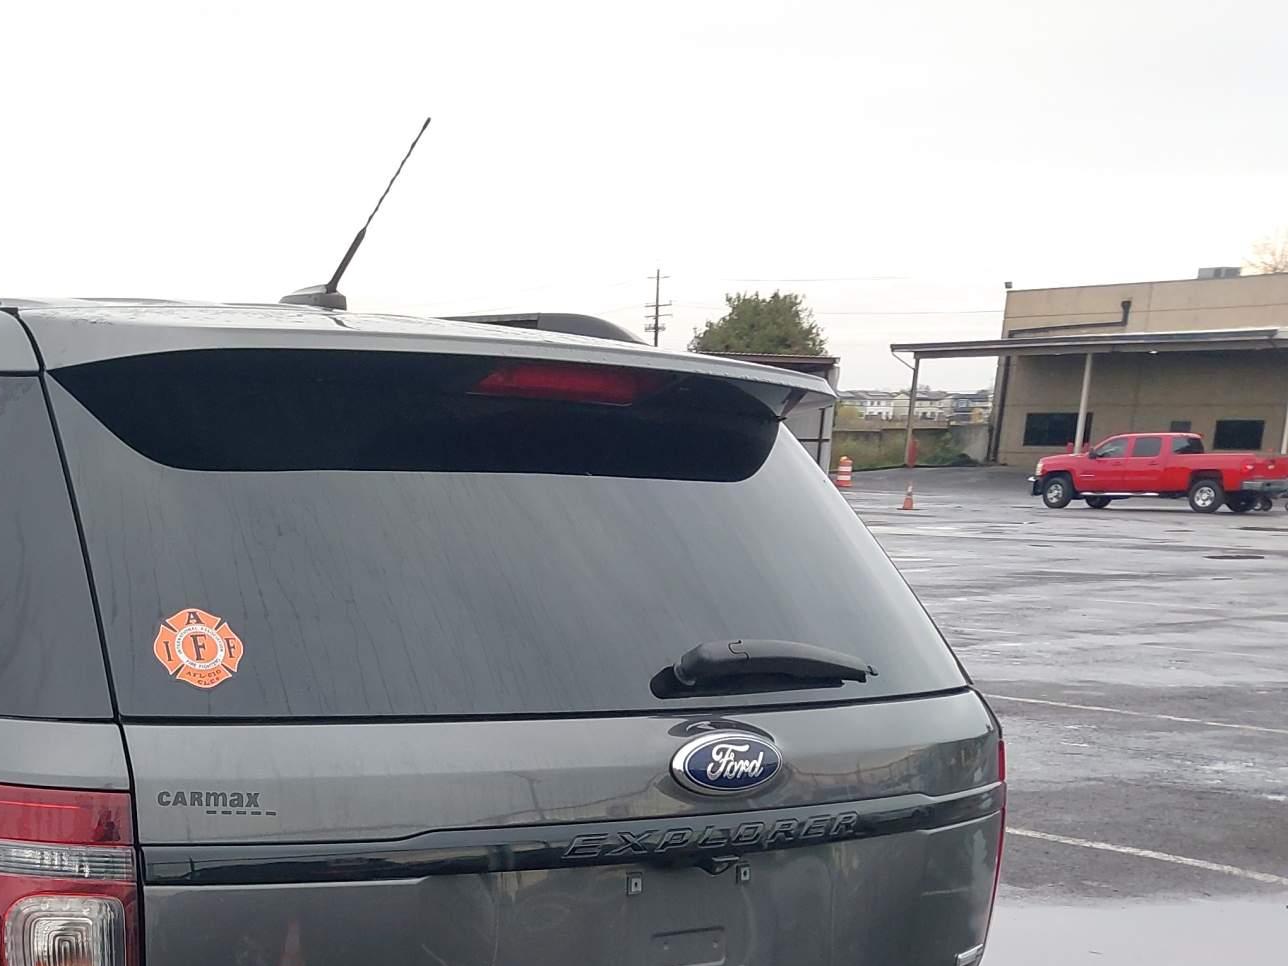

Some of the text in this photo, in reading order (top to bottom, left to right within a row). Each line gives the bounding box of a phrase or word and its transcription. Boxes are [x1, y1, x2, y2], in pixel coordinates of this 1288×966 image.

[185, 611, 205, 625] A
[190, 634, 207, 661] F
[224, 637, 236, 659] F
[706, 743, 765, 780] Ford
[561, 811, 860, 859] EXPLORER
